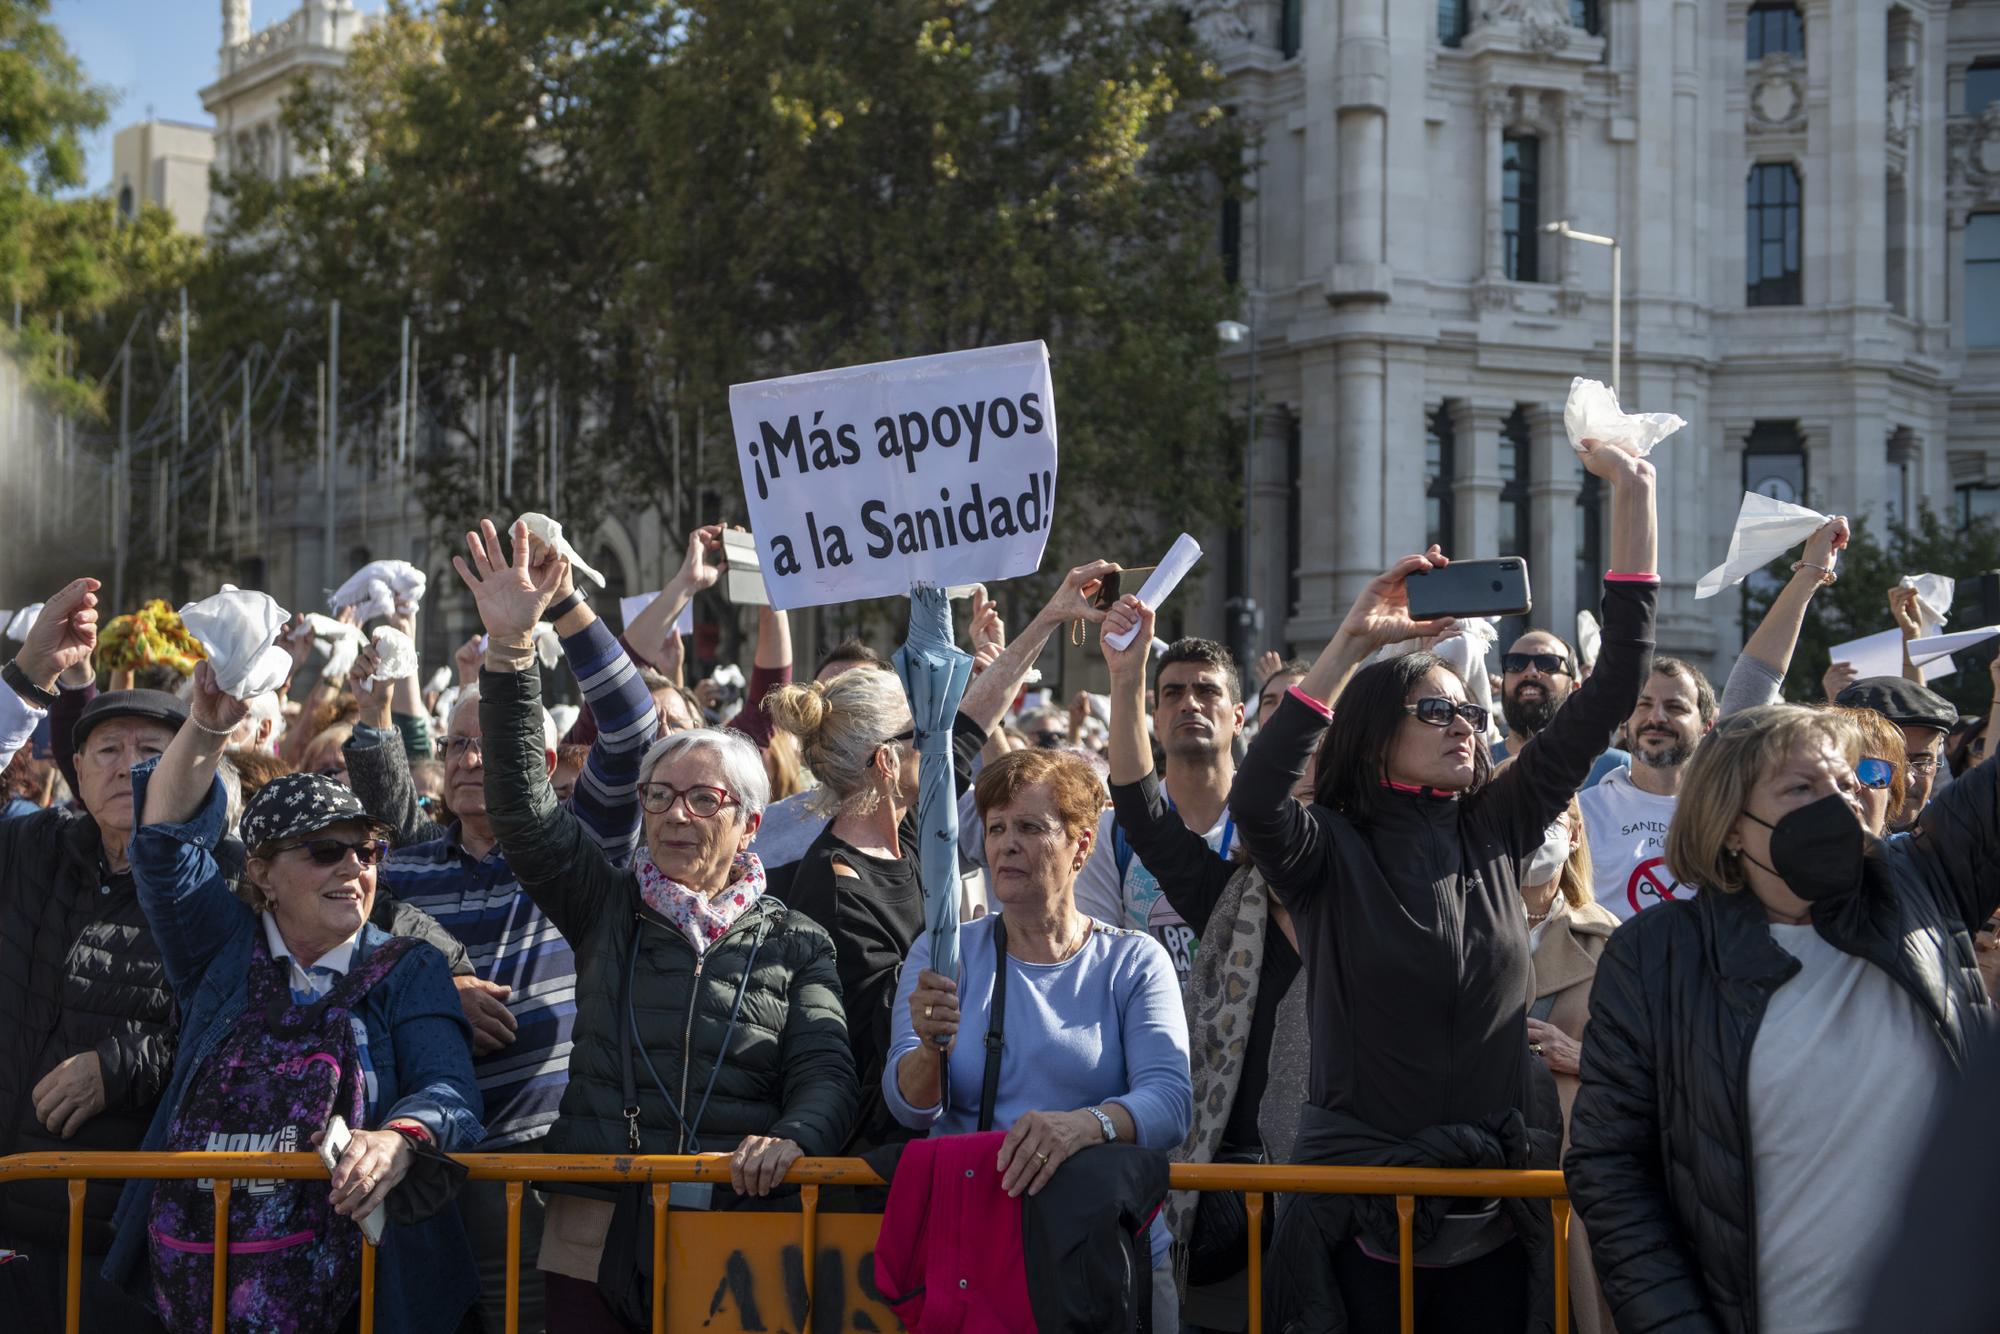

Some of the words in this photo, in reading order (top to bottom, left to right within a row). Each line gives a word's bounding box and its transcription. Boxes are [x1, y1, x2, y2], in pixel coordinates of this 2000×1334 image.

[748, 410, 862, 501] ¡Más
[874, 393, 1044, 474] apoyos
[770, 534, 802, 577] a
[805, 512, 854, 570] la
[860, 470, 1052, 560] Sanidad!
